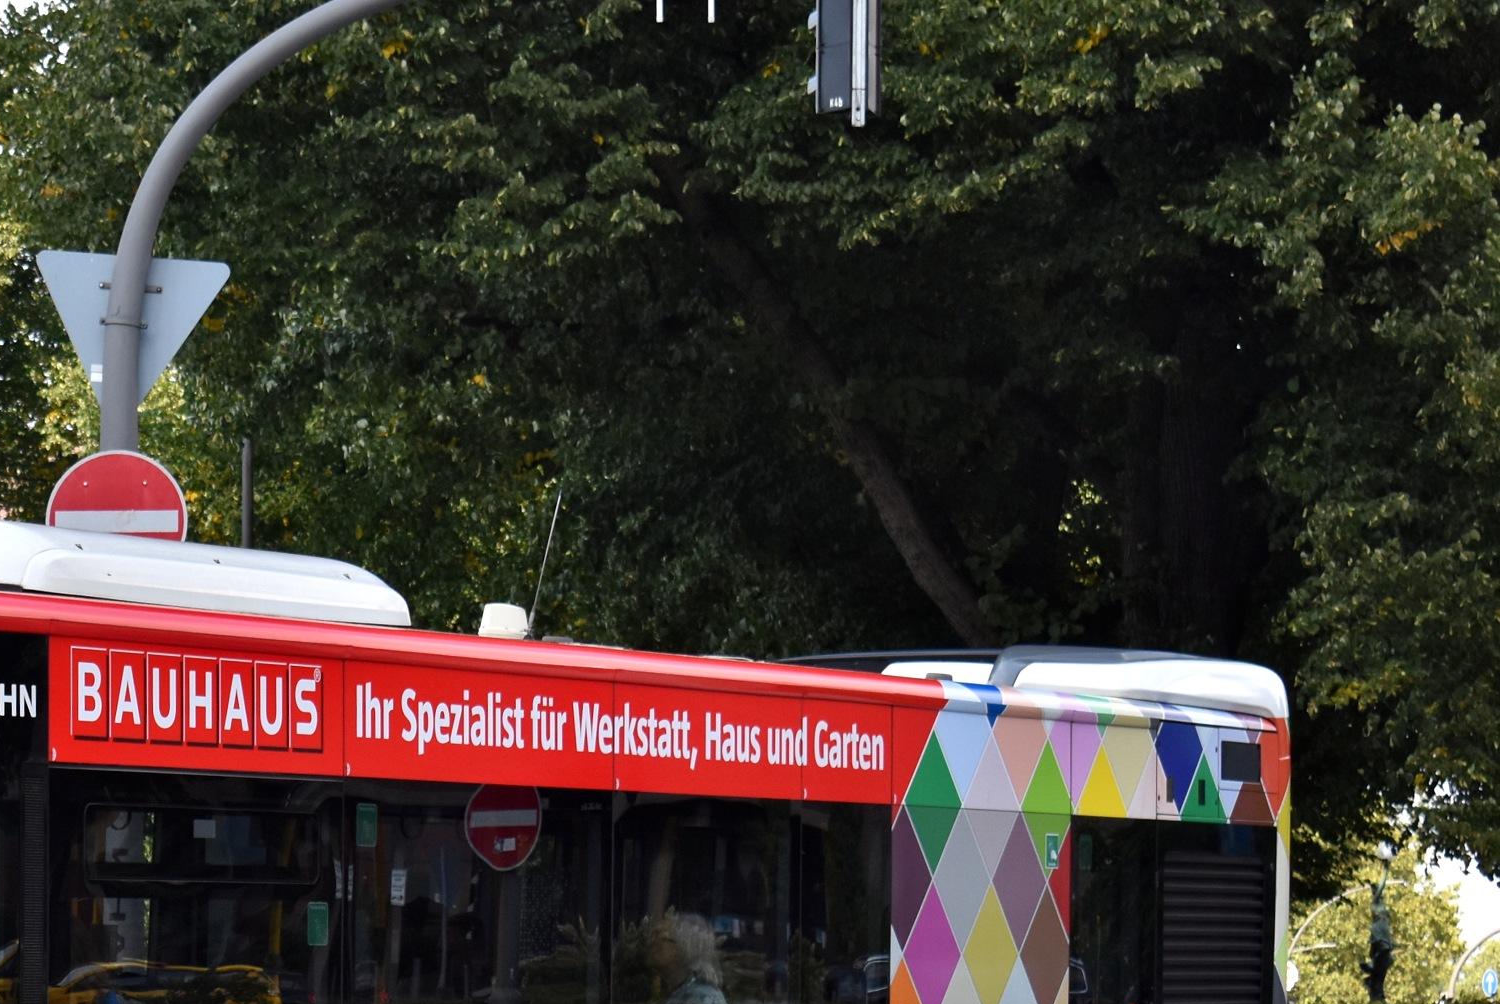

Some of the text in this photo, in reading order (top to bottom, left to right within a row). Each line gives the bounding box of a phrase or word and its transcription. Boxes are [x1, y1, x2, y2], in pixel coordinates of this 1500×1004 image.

[355, 681, 885, 771] Ihr Spezialist für Werkstatt, Haus und Garten
